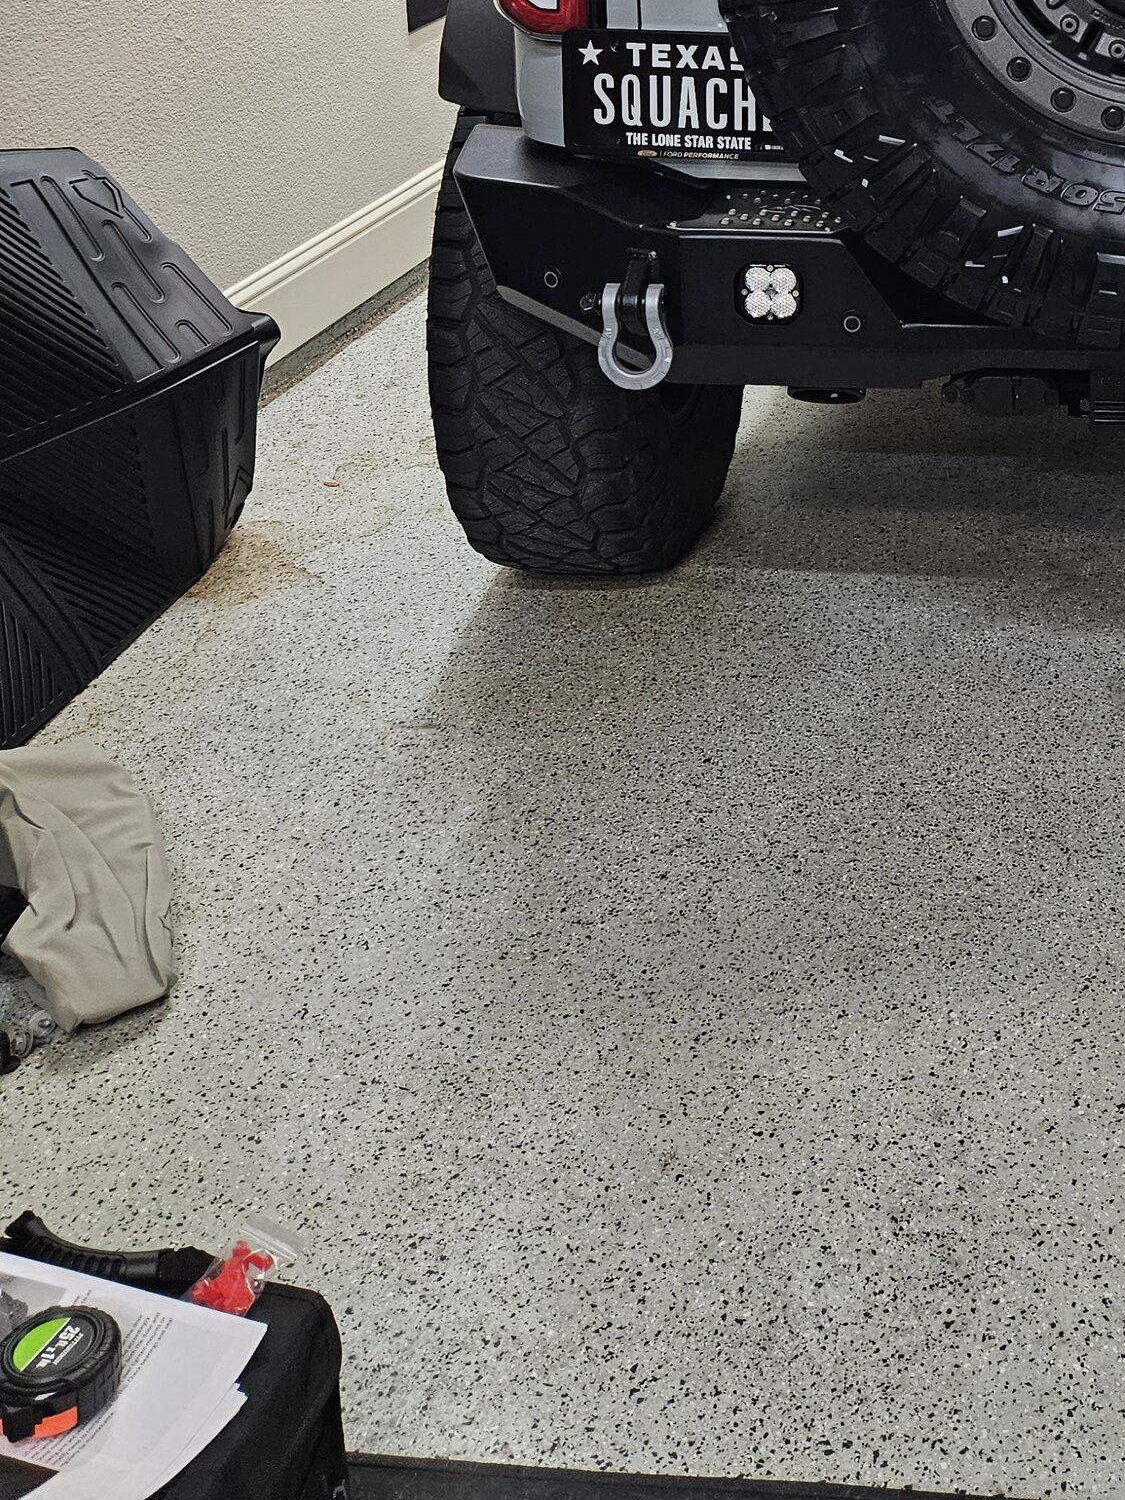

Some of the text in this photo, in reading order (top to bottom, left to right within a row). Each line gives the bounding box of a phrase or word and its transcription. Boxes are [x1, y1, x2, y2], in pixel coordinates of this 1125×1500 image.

[593, 72, 773, 132] SQUACH
[626, 132, 648, 146] THE
[651, 133, 681, 148] LONE
[684, 134, 714, 149] STAR
[716, 136, 752, 151] STATE
[683, 151, 740, 160] PERFORMANCE
